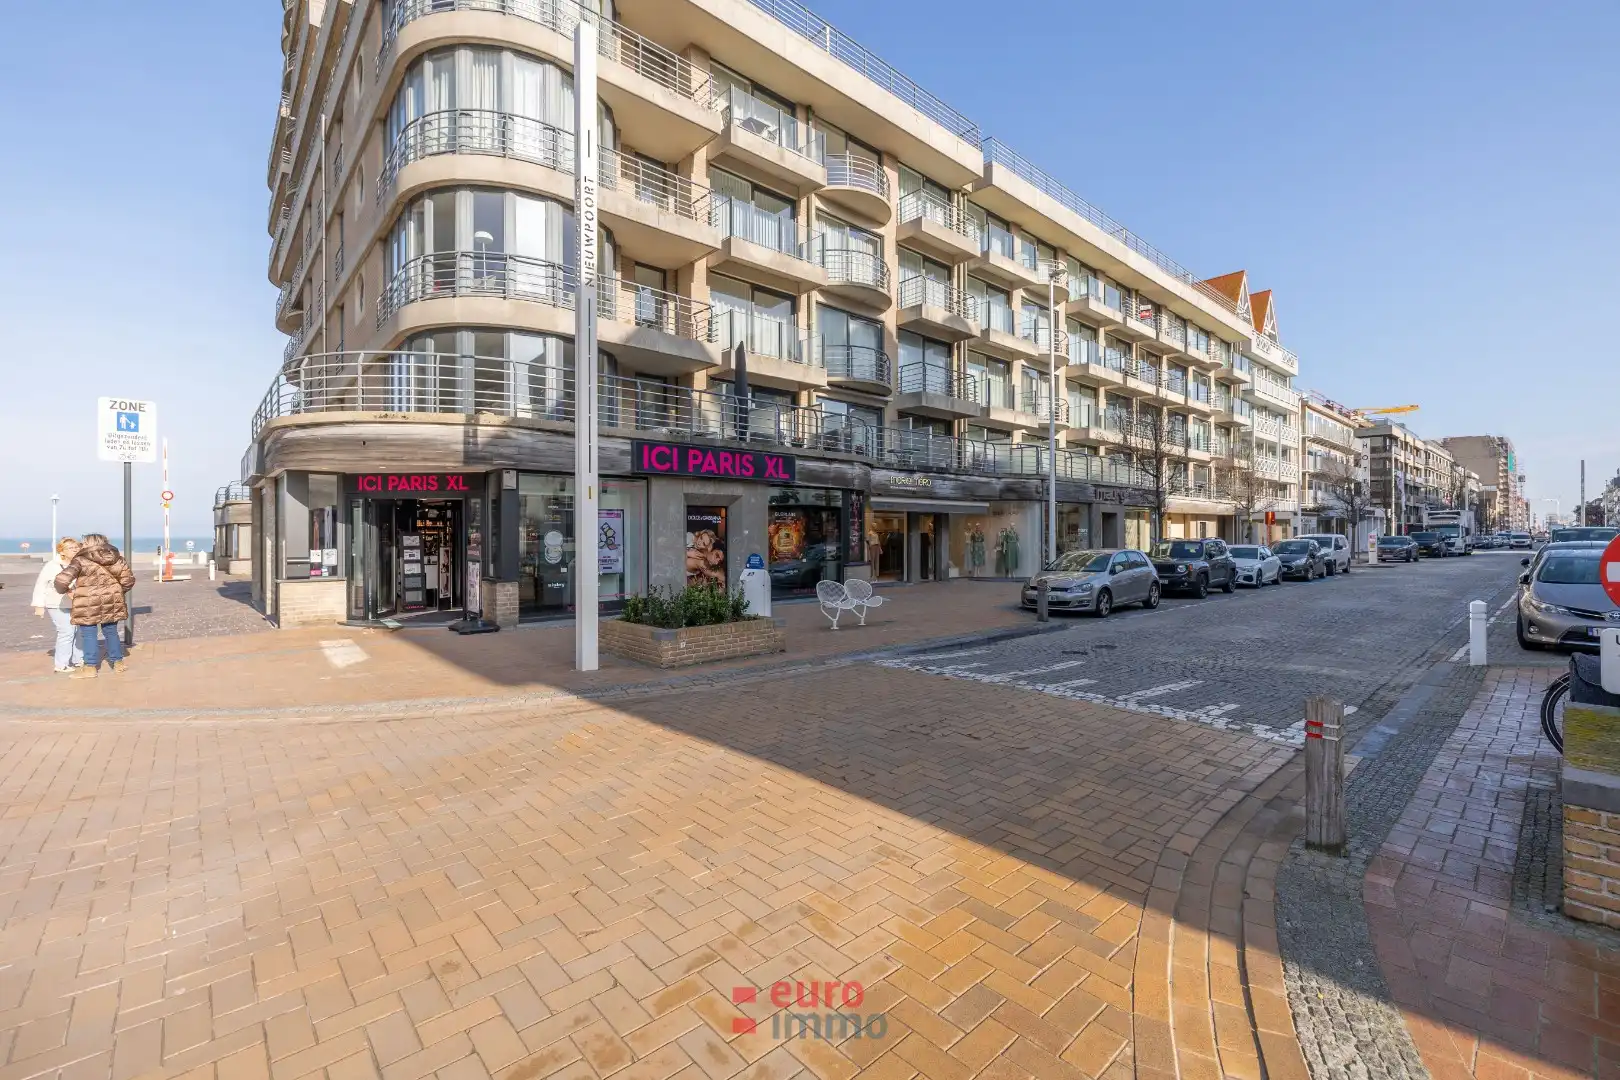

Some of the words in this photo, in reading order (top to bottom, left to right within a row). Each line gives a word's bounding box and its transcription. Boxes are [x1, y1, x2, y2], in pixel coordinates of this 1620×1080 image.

[584, 175, 595, 288] NIEUWPOORT
[109, 400, 147, 412] ZONE
[642, 444, 679, 471] ICI
[687, 449, 755, 477] PARIS
[764, 455, 790, 479] XL
[357, 475, 383, 491] ICI
[388, 475, 439, 491] PARIS
[445, 475, 470, 491] XL
